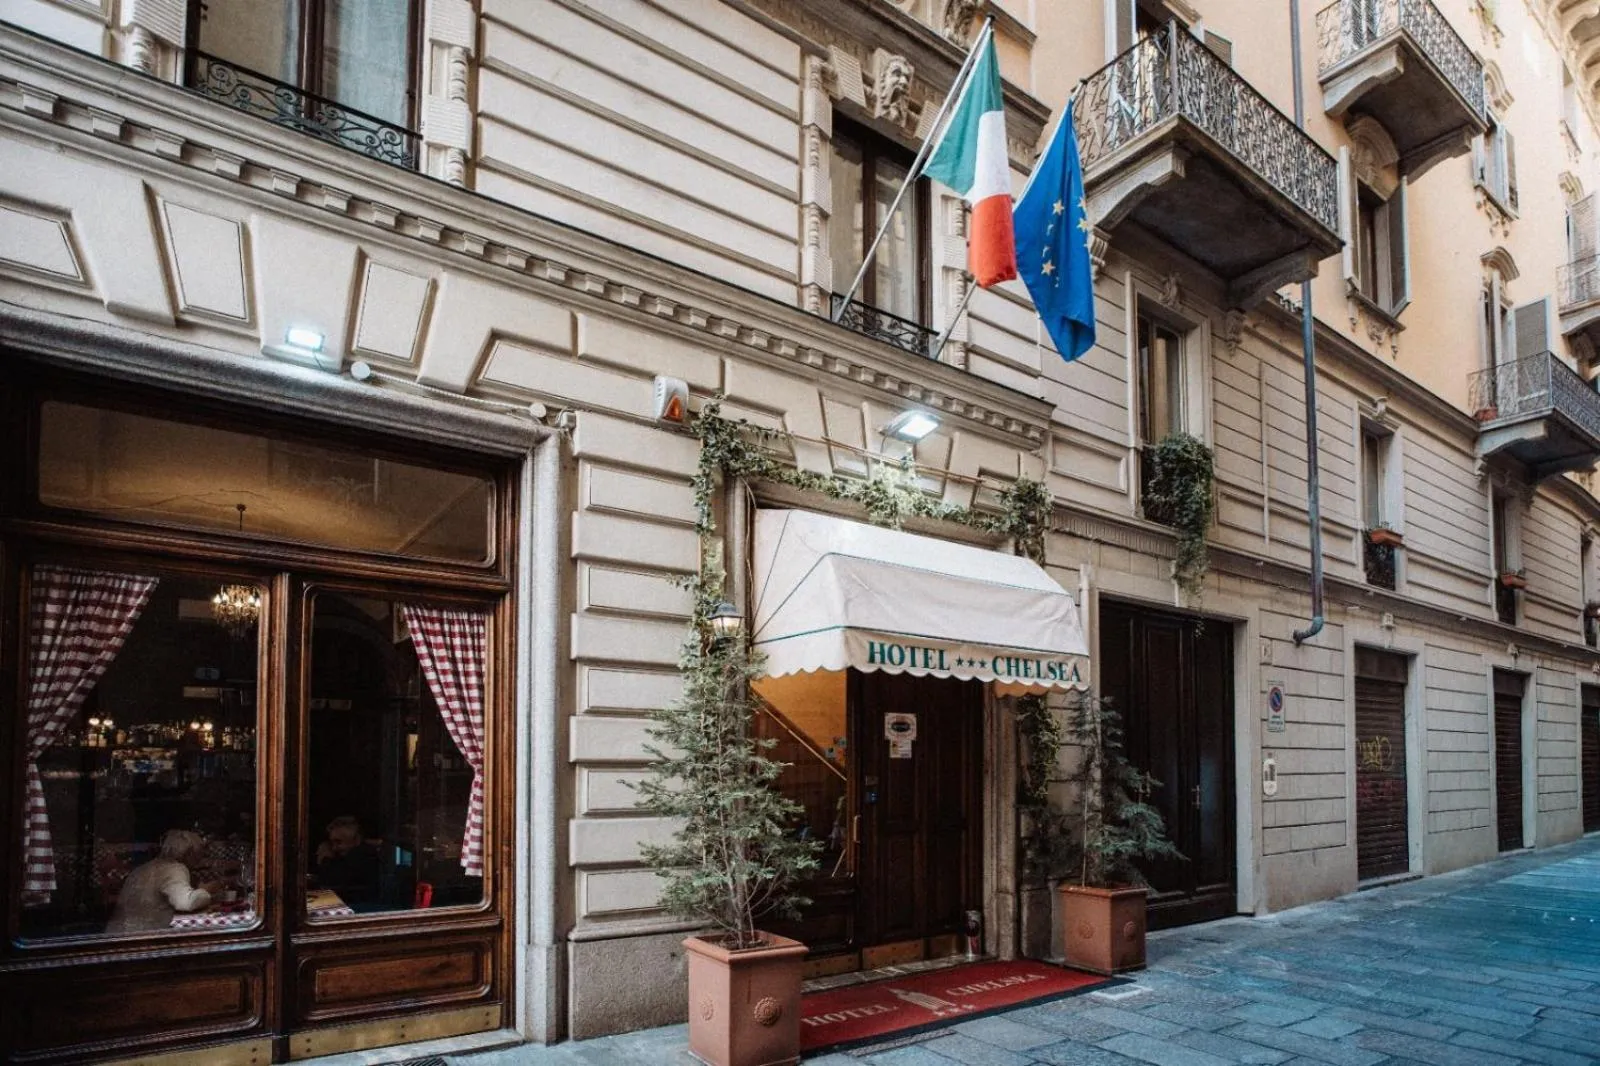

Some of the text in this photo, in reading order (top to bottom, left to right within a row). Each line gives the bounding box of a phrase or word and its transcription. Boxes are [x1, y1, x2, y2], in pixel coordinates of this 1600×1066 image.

[867, 640, 1081, 682] HOTEL CHELSEA
[801, 1004, 899, 1026] HOTEL
